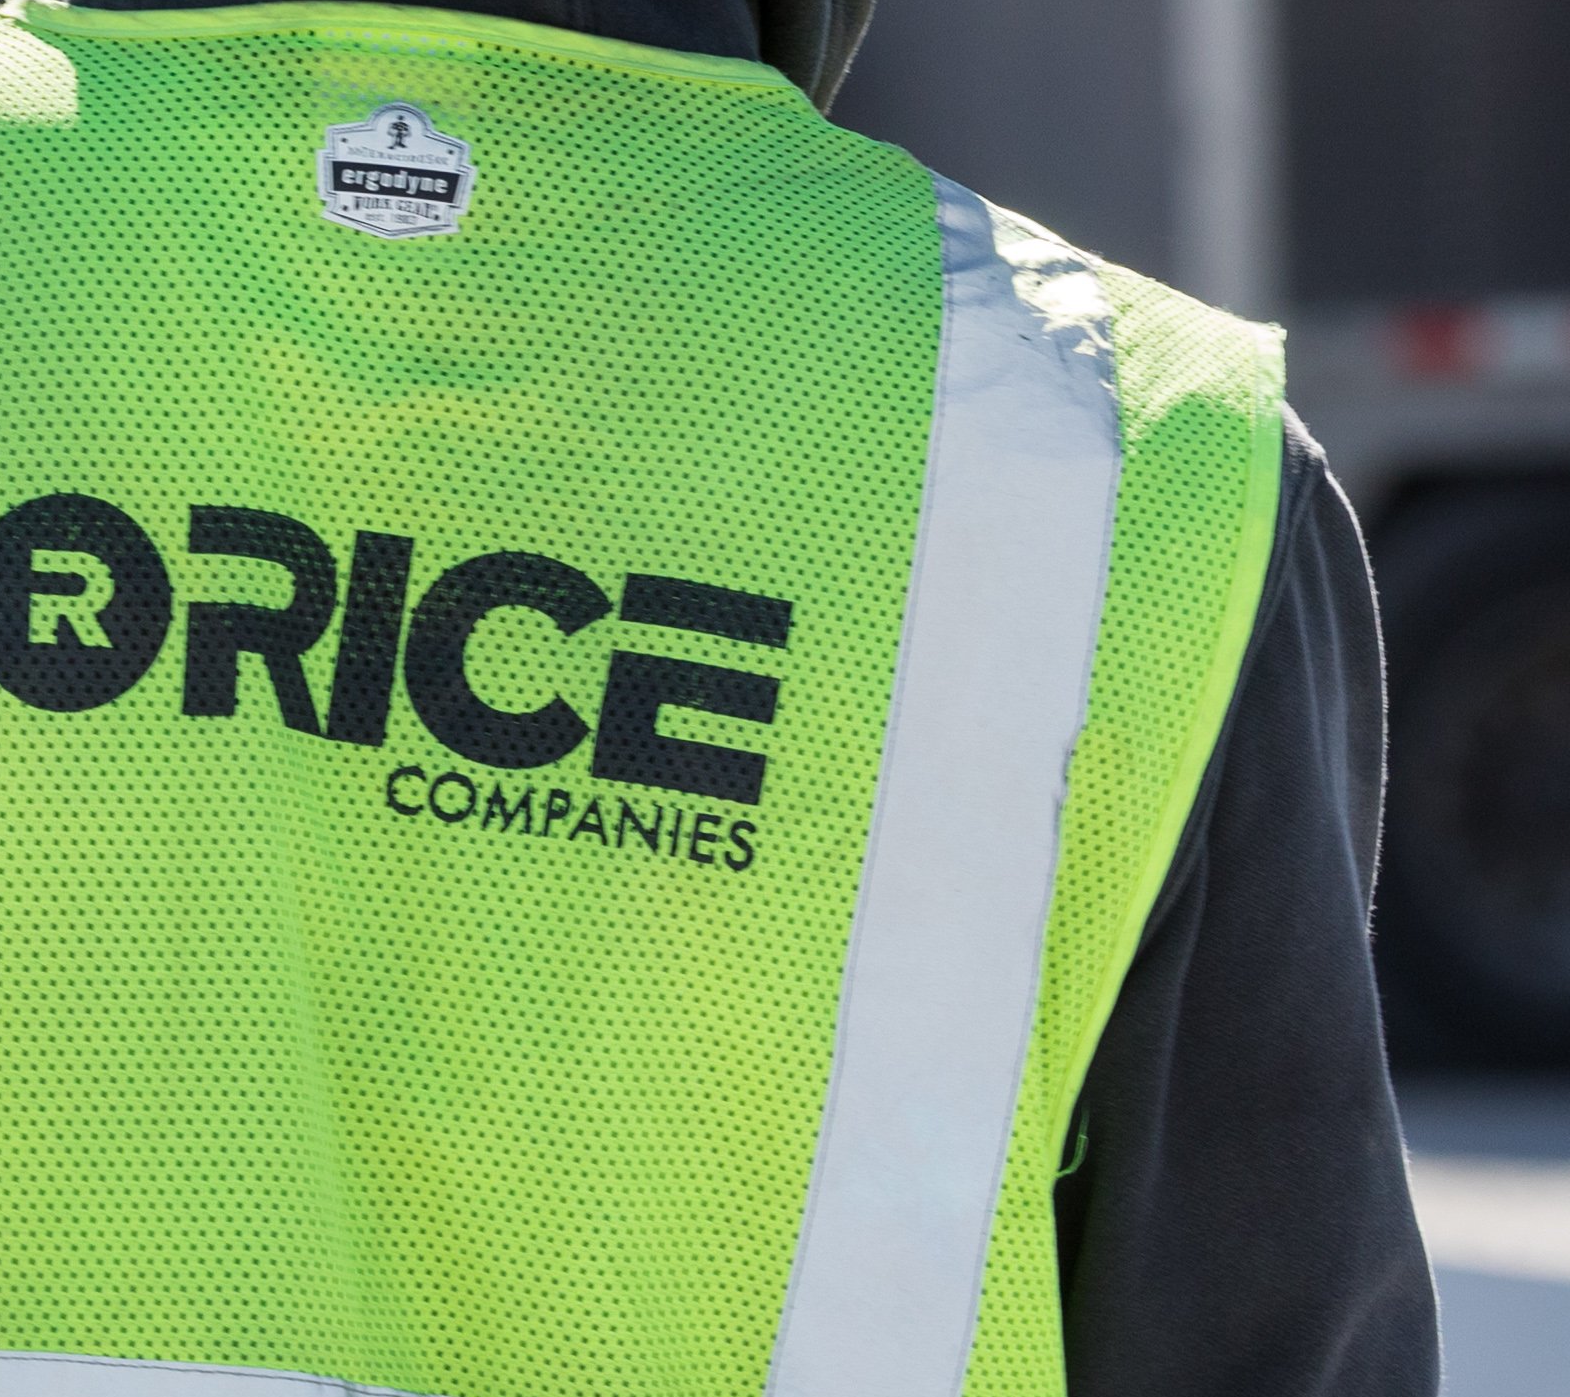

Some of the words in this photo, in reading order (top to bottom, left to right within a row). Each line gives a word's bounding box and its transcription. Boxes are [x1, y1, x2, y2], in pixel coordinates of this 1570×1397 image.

[341, 168, 448, 195] ergodyne
[182, 504, 795, 806] RICE
[386, 766, 757, 871] COMPANIES
